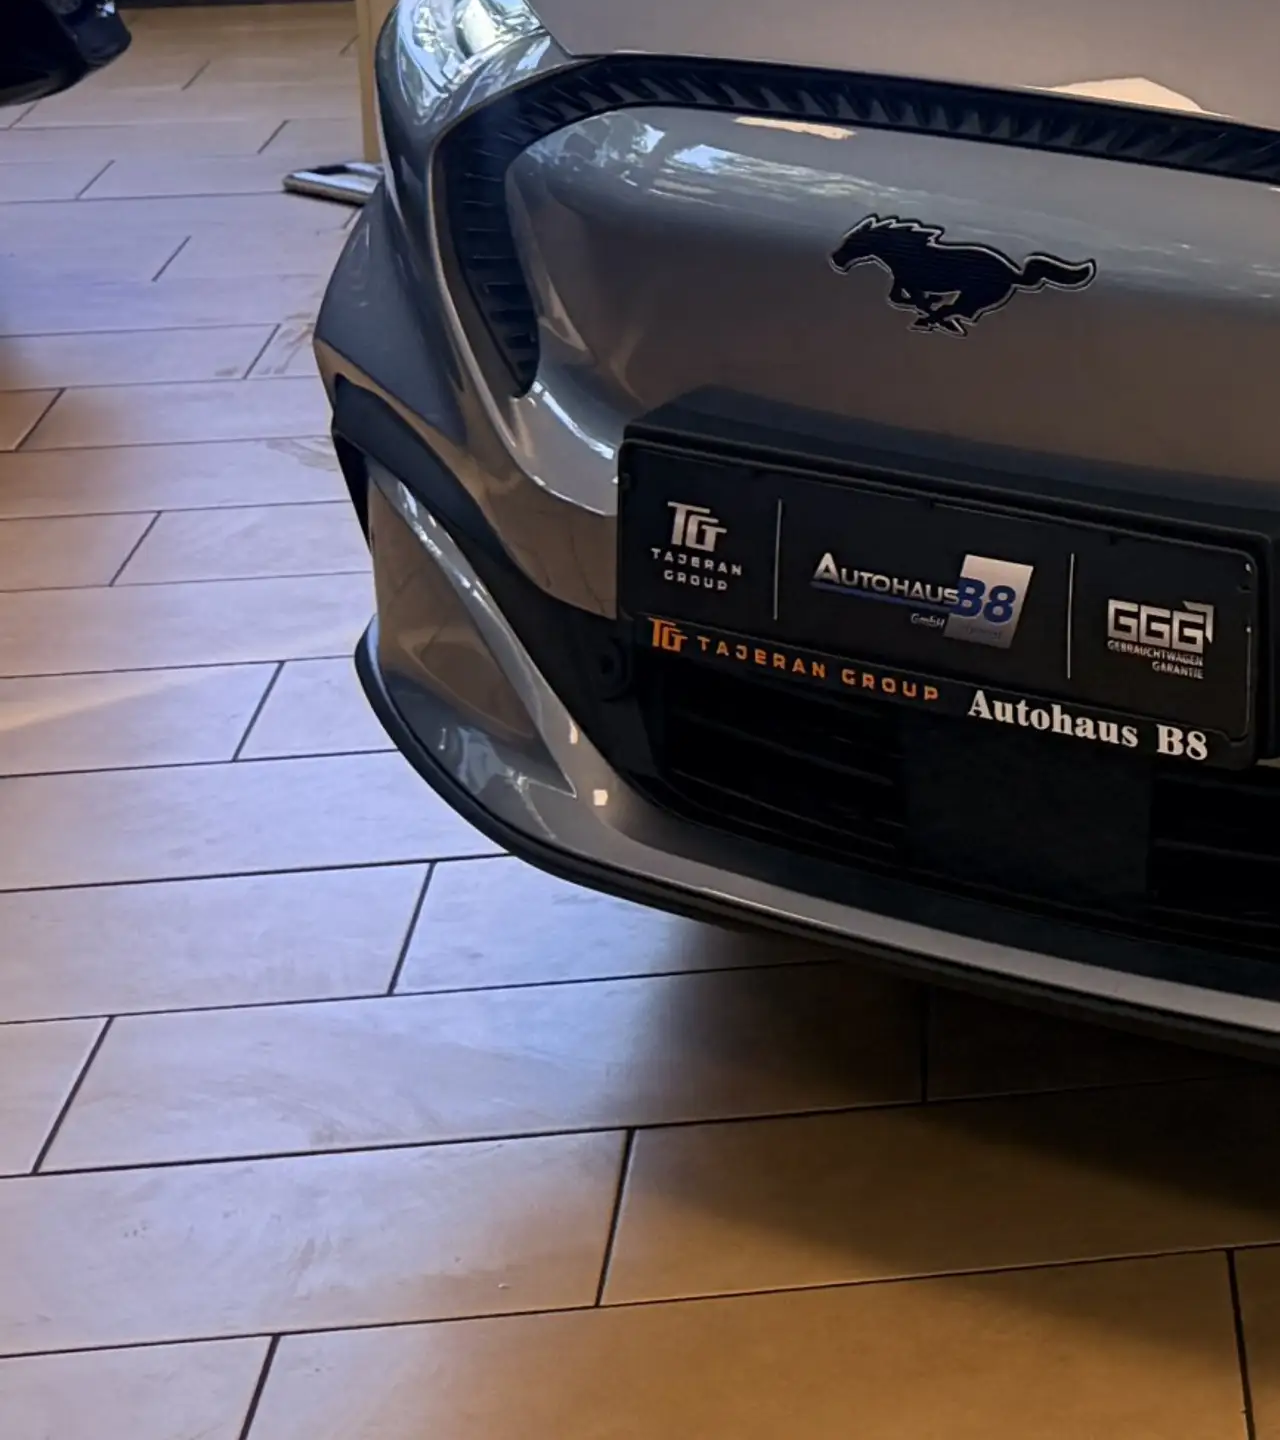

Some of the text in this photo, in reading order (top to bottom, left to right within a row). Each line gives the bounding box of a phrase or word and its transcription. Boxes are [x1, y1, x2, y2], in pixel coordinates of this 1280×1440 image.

[650, 547, 743, 576] TAJERAN
[663, 569, 729, 592] GROUP
[1107, 598, 1214, 655] GGG
[1107, 640, 1204, 667] GEBRAUCHTWAGEN
[697, 635, 827, 679] TAJERAN
[841, 667, 939, 702] GROUP
[1151, 660, 1205, 680] GARANTIE
[967, 689, 1209, 761] Autohaus B8
